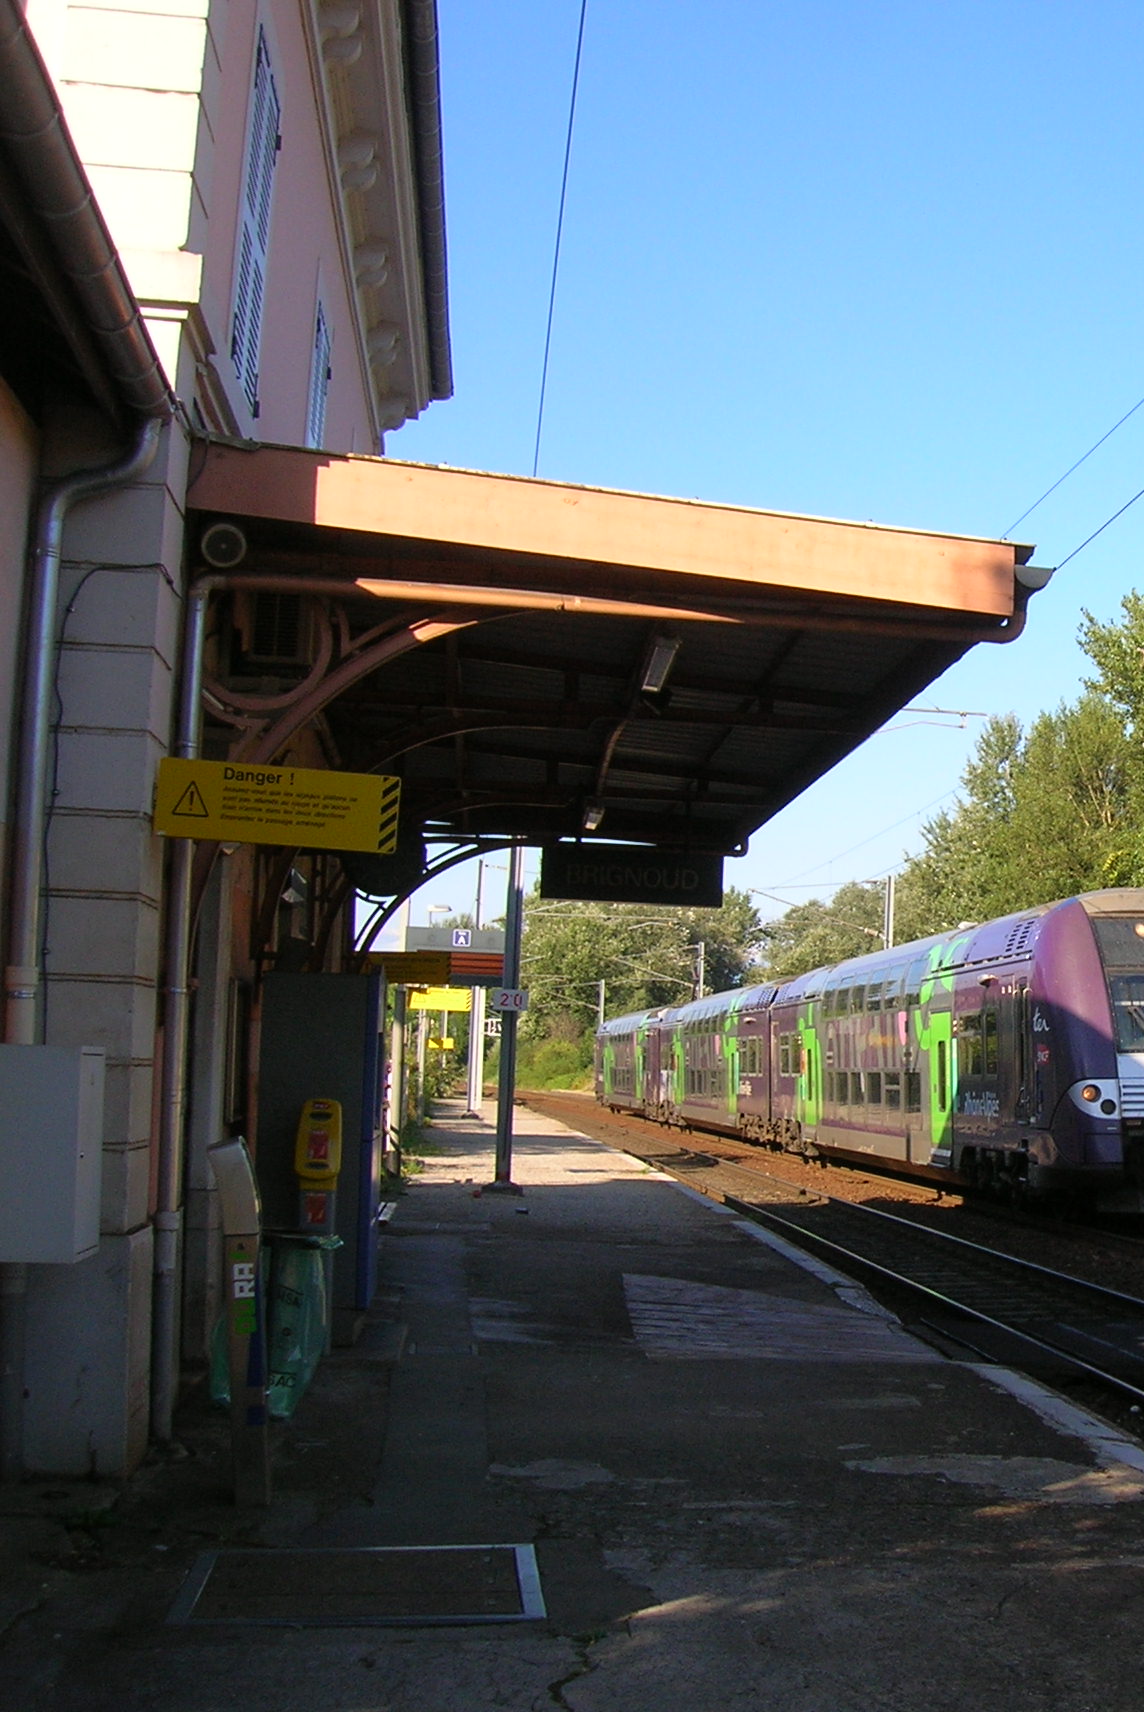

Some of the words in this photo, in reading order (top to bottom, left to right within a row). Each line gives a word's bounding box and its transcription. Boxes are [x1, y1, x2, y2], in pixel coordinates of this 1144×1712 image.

[223, 767, 283, 786] Danger
[289, 773, 296, 785] !
[566, 863, 699, 890] BRIGNOUD
[1032, 1007, 1051, 1032] ter
